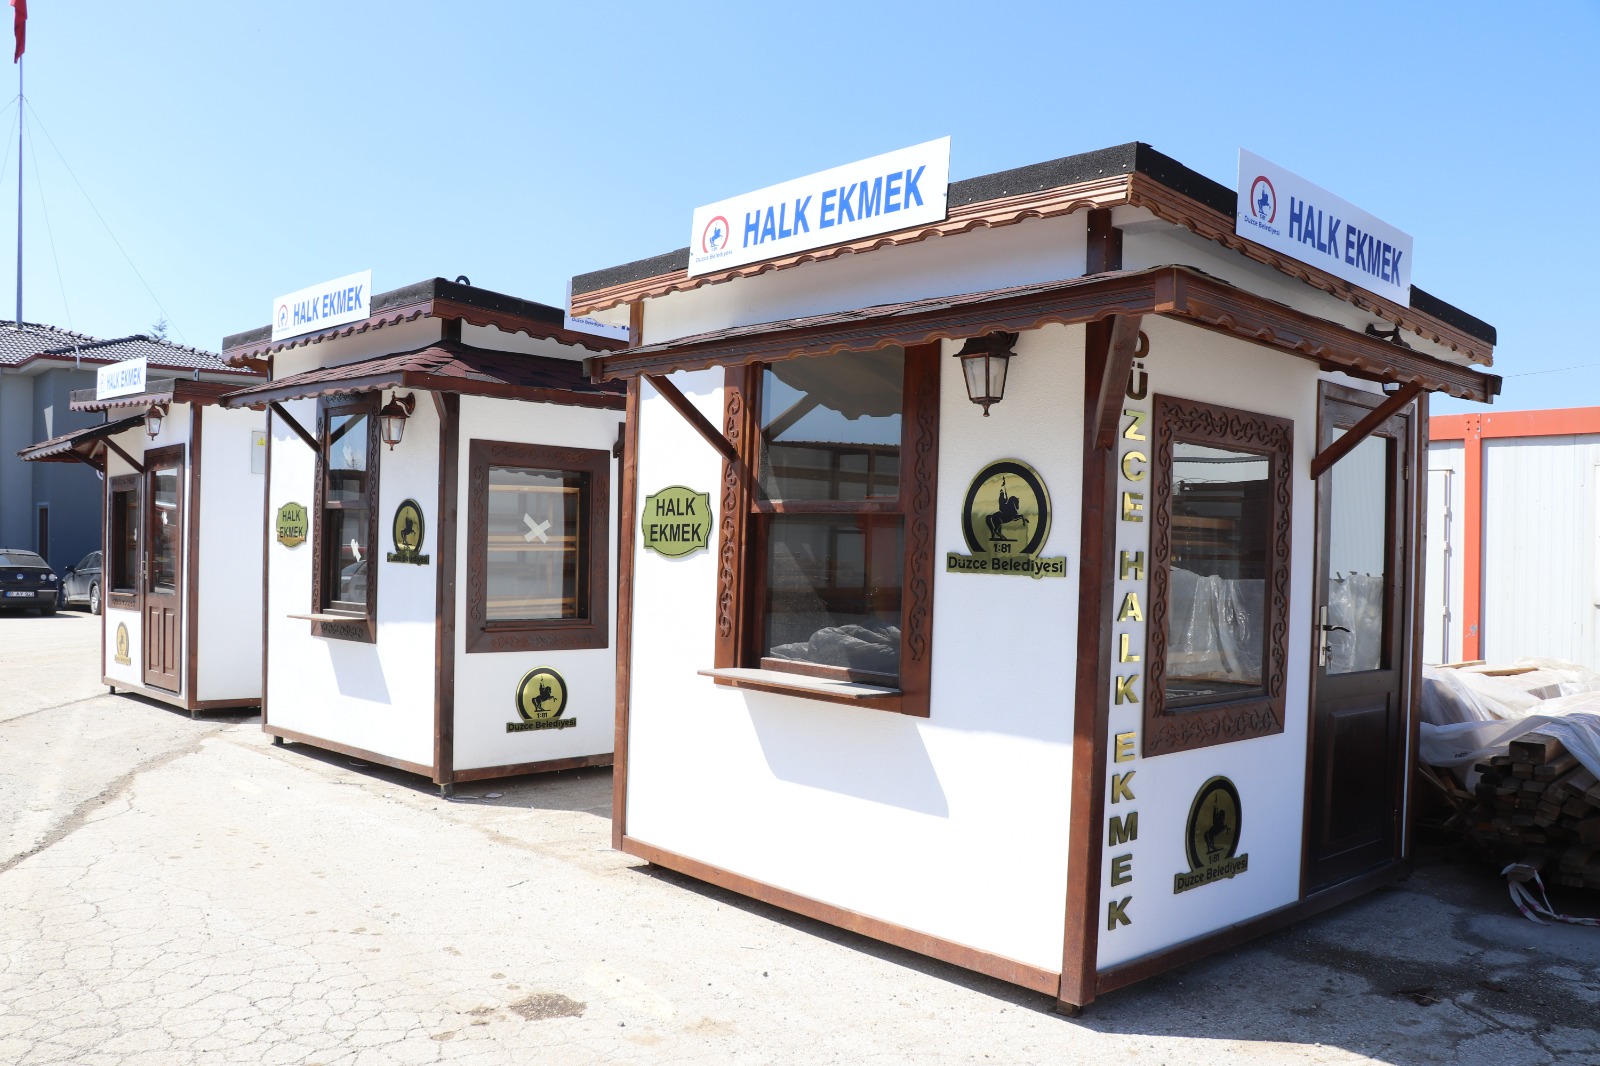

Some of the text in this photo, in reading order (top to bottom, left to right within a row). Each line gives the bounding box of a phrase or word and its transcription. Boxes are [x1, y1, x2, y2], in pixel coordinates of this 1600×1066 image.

[743, 165, 926, 248] HALK EKMEK
[1289, 196, 1402, 287] HALK EKMEK
[293, 284, 363, 326] HALK EKMEK
[121, 366, 142, 388] EKMEK
[282, 510, 301, 522] HALK
[656, 497, 696, 516] HALK
[279, 526, 304, 538] EKMEK
[649, 523, 702, 542] EKMEK
[991, 557, 1063, 575] Belediyesi
[1115, 550, 1145, 705] HALK
[535, 719, 576, 729] Belediyesi
[1108, 731, 1139, 931] EKMEK
[1206, 858, 1248, 880] Belediyesi
